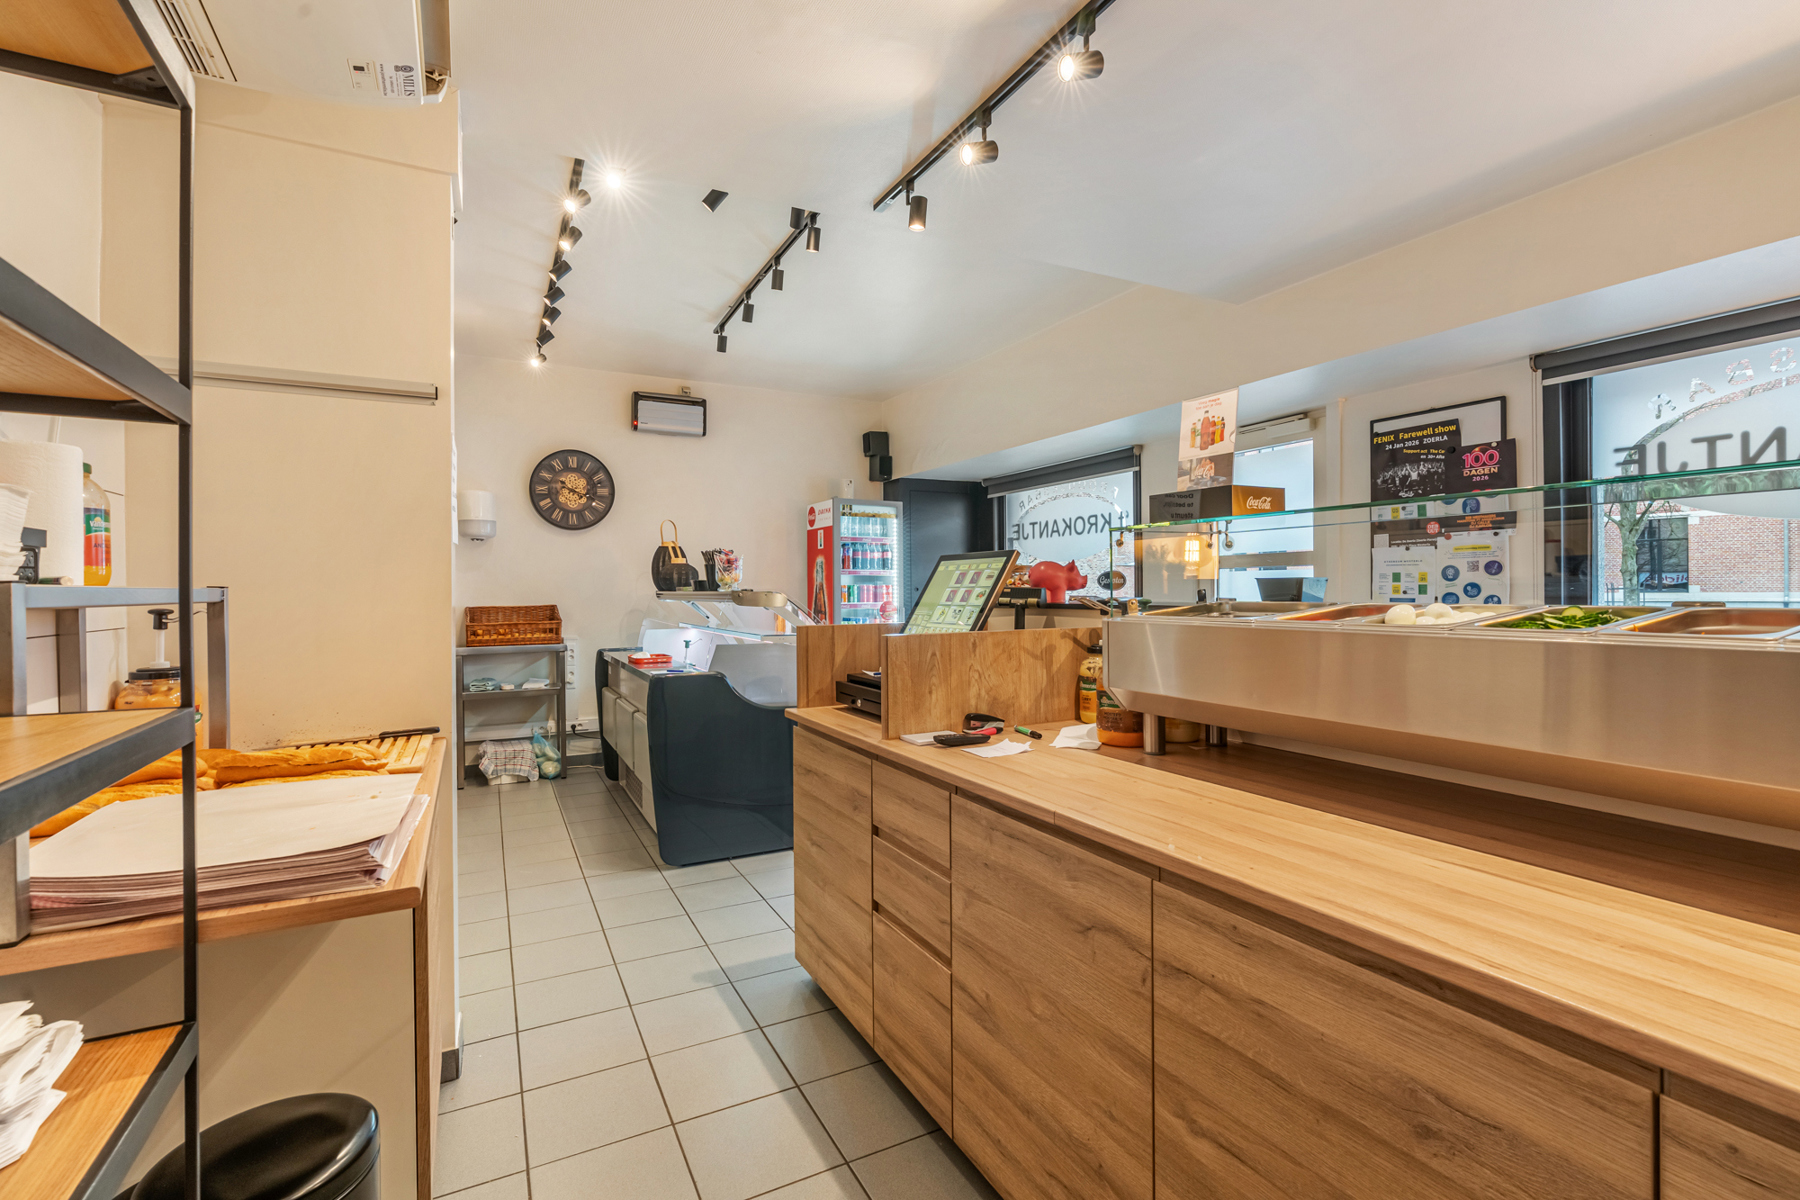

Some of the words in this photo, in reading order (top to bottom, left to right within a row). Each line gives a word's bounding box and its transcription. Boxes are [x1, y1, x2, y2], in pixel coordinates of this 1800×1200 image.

[402, 74, 416, 97] MILIS
[1374, 434, 1394, 444] FENIX
[1399, 427, 1434, 440] Farewell
[1434, 424, 1456, 434] show
[1423, 435, 1448, 444] ZOERLA
[1462, 450, 1500, 468] 100
[1463, 466, 1498, 476] DAGEN
[1246, 496, 1272, 510] Coca-Cola
[1100, 576, 1124, 586] Gesoten
